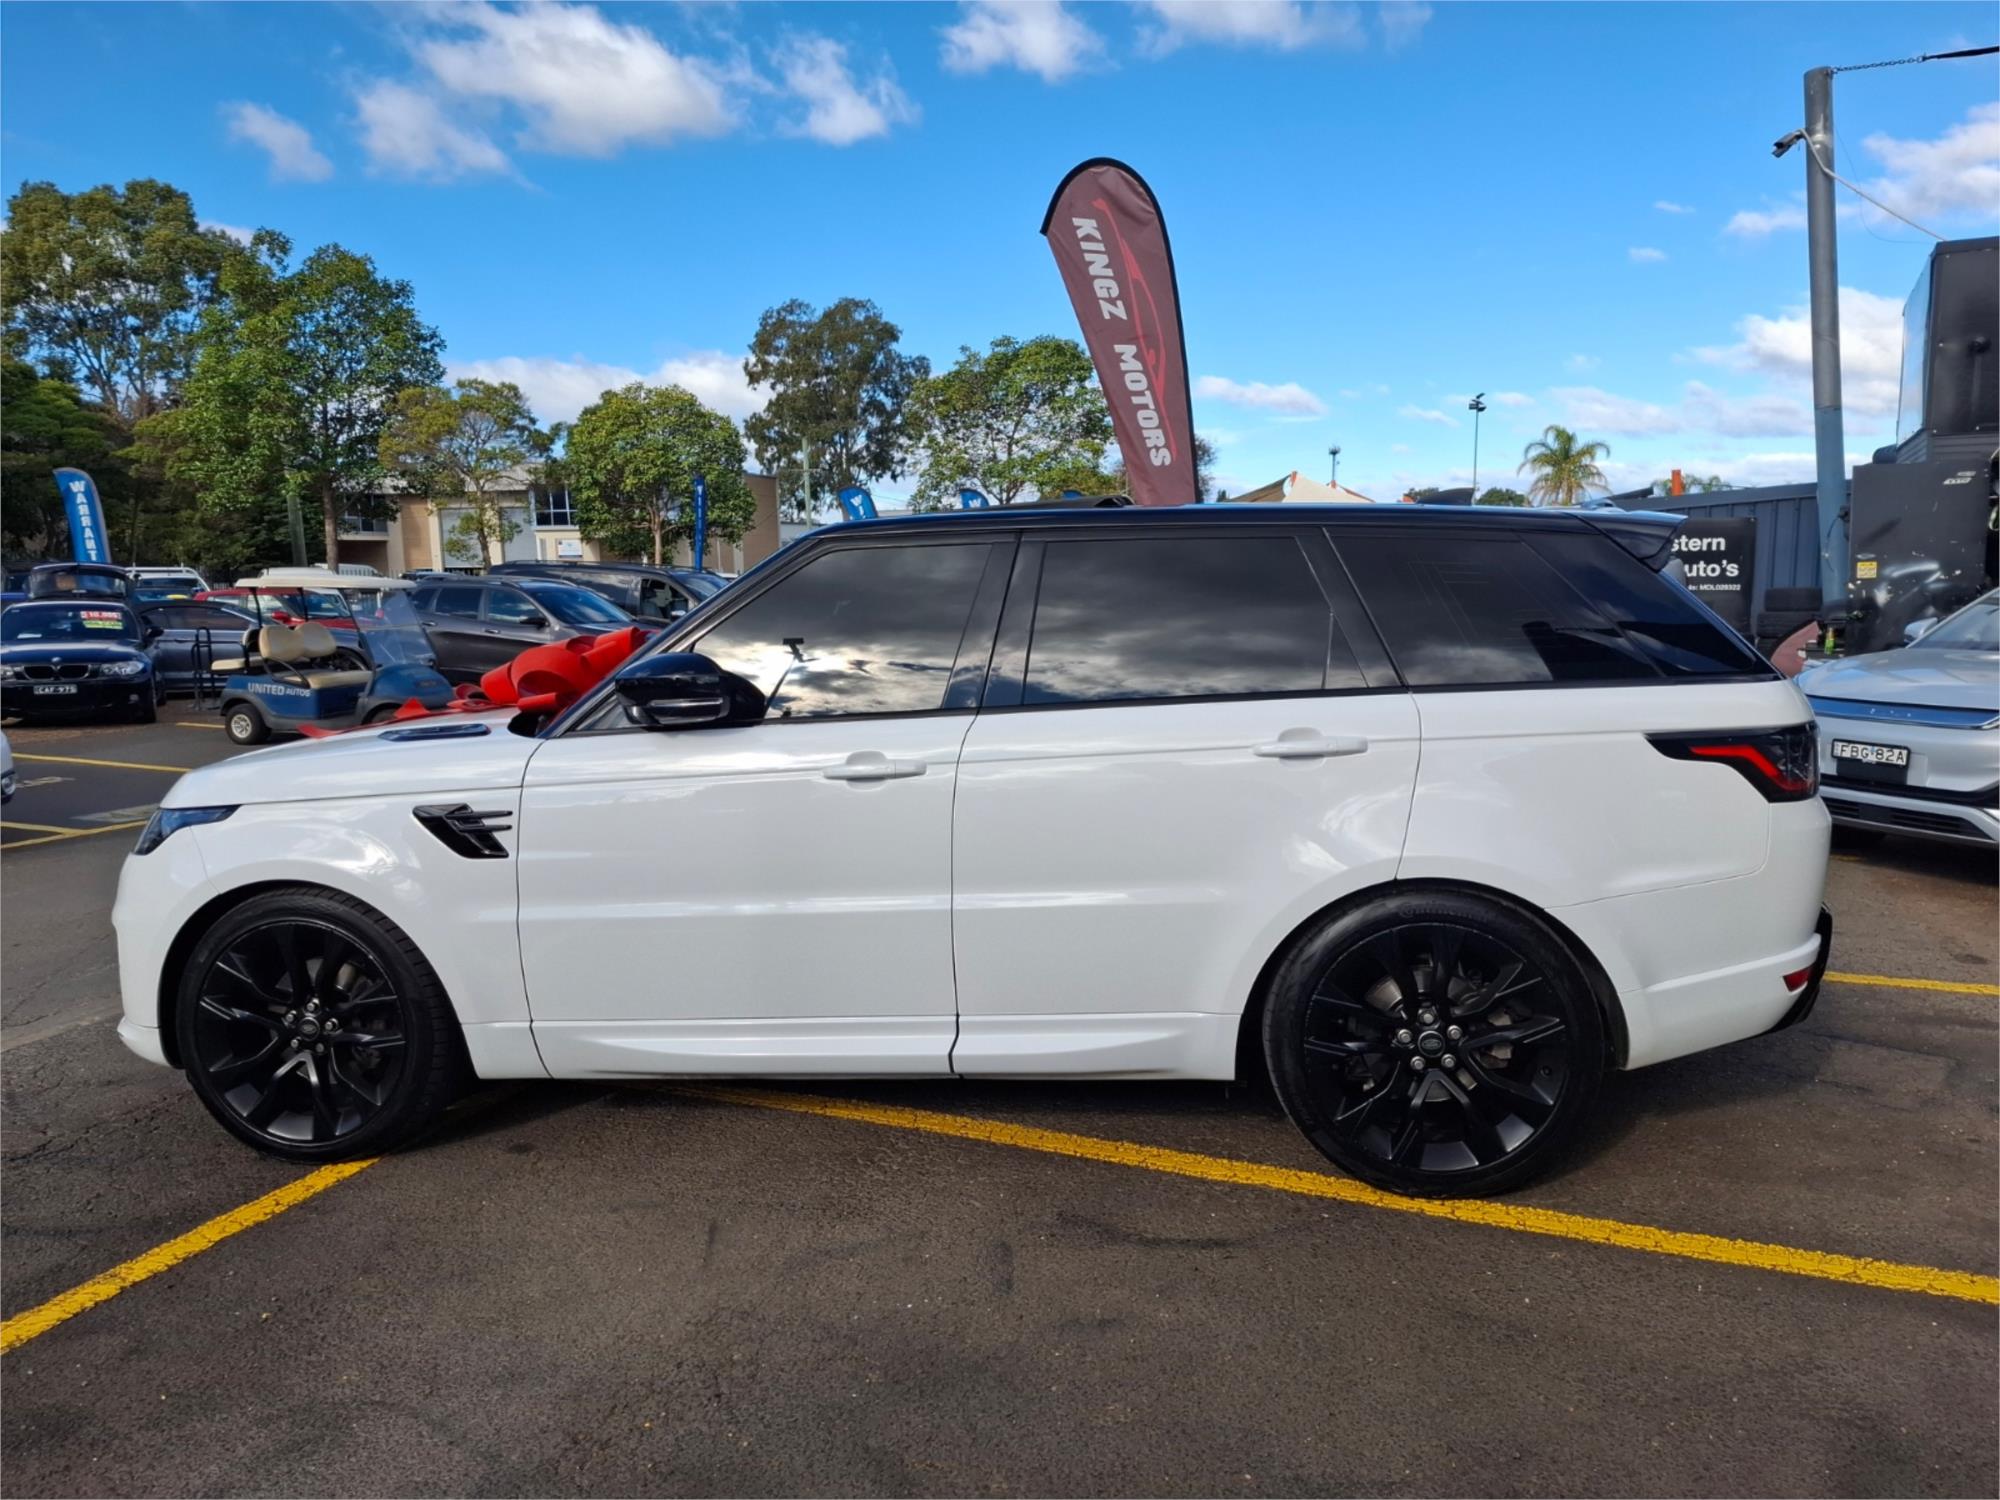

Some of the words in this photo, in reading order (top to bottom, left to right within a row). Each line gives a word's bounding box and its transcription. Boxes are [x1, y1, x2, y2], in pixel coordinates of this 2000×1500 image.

[1072, 217, 1127, 320] KINGZ
[1113, 344, 1171, 467] MOTORS
[248, 682, 285, 695] UNITED
[286, 687, 311, 697] AUTOS
